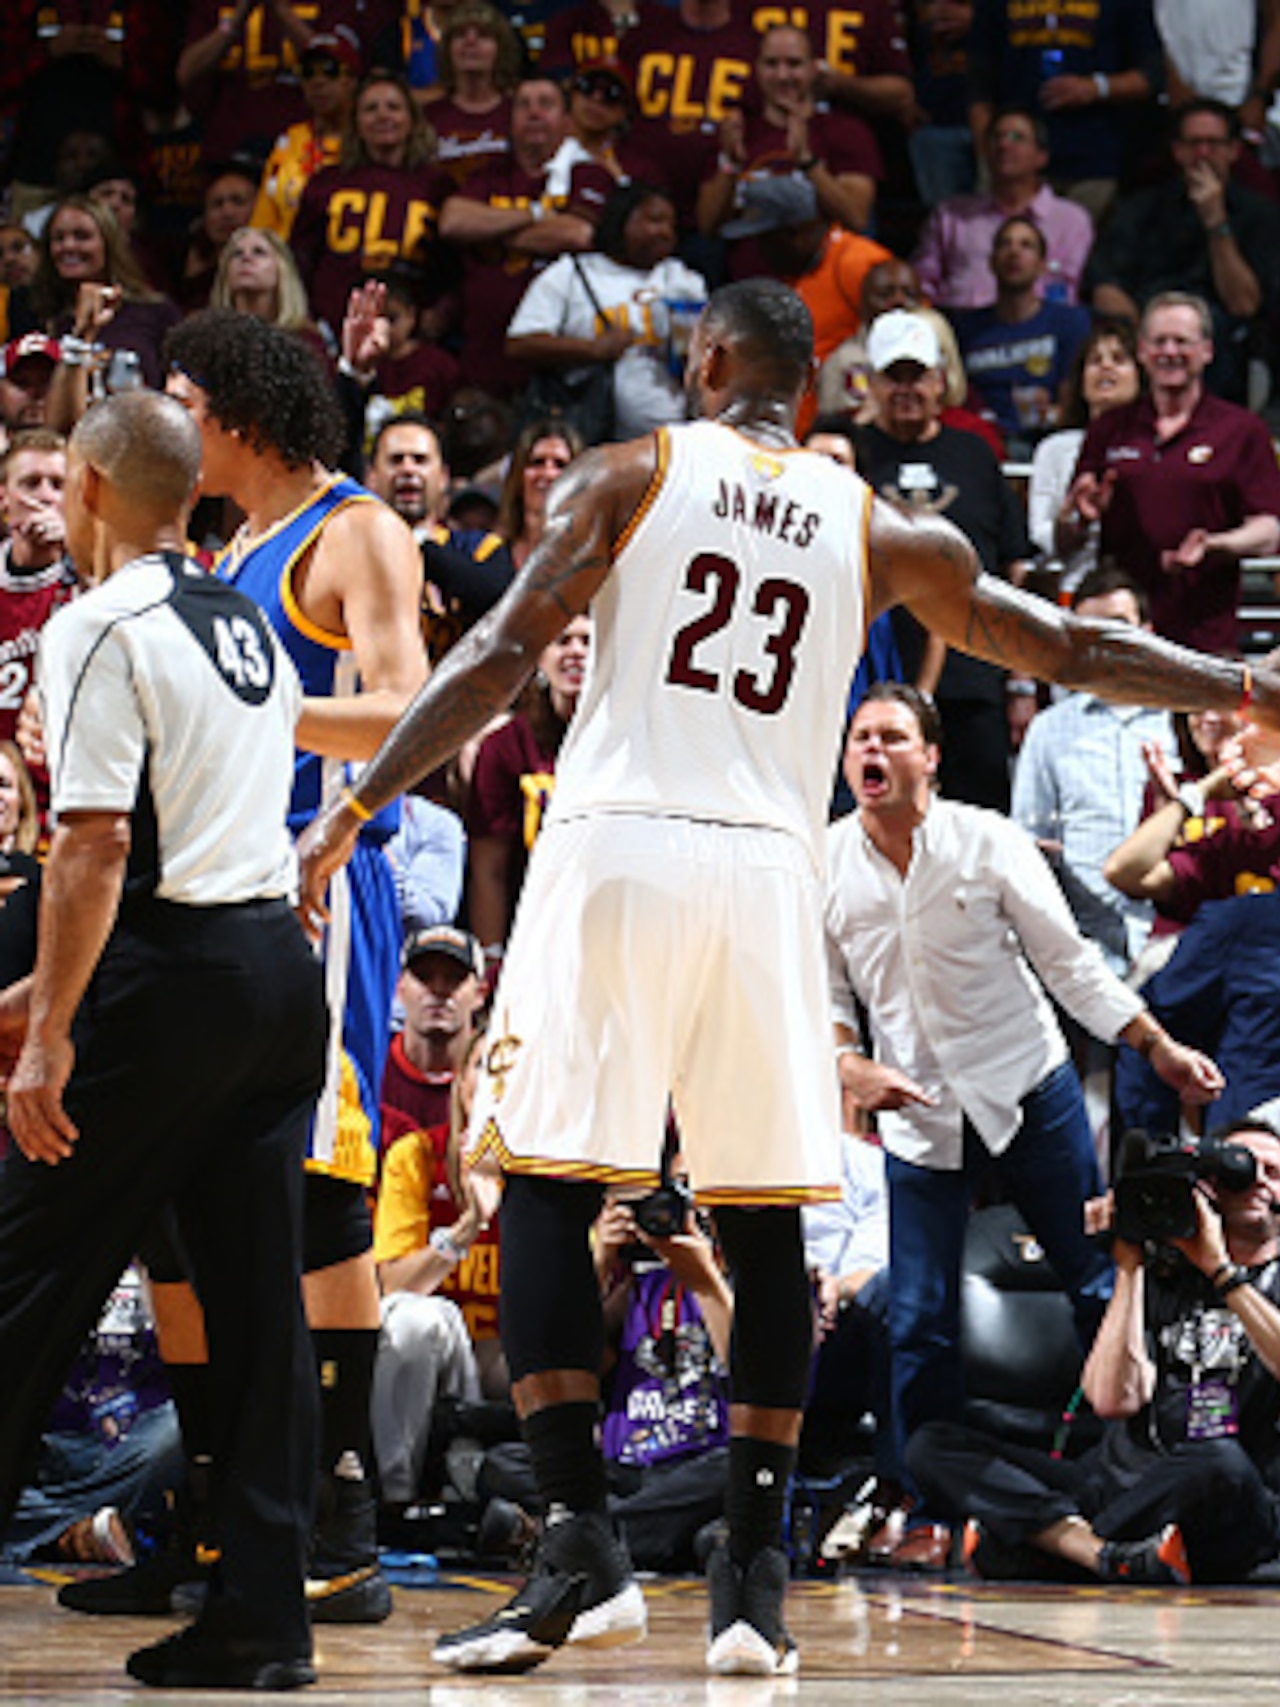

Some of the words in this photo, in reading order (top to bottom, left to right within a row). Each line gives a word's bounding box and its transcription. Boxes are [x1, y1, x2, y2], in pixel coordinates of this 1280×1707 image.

[636, 53, 750, 122] CLE
[714, 479, 822, 549] JAMES
[213, 616, 269, 688] 43
[665, 551, 811, 715] 23
